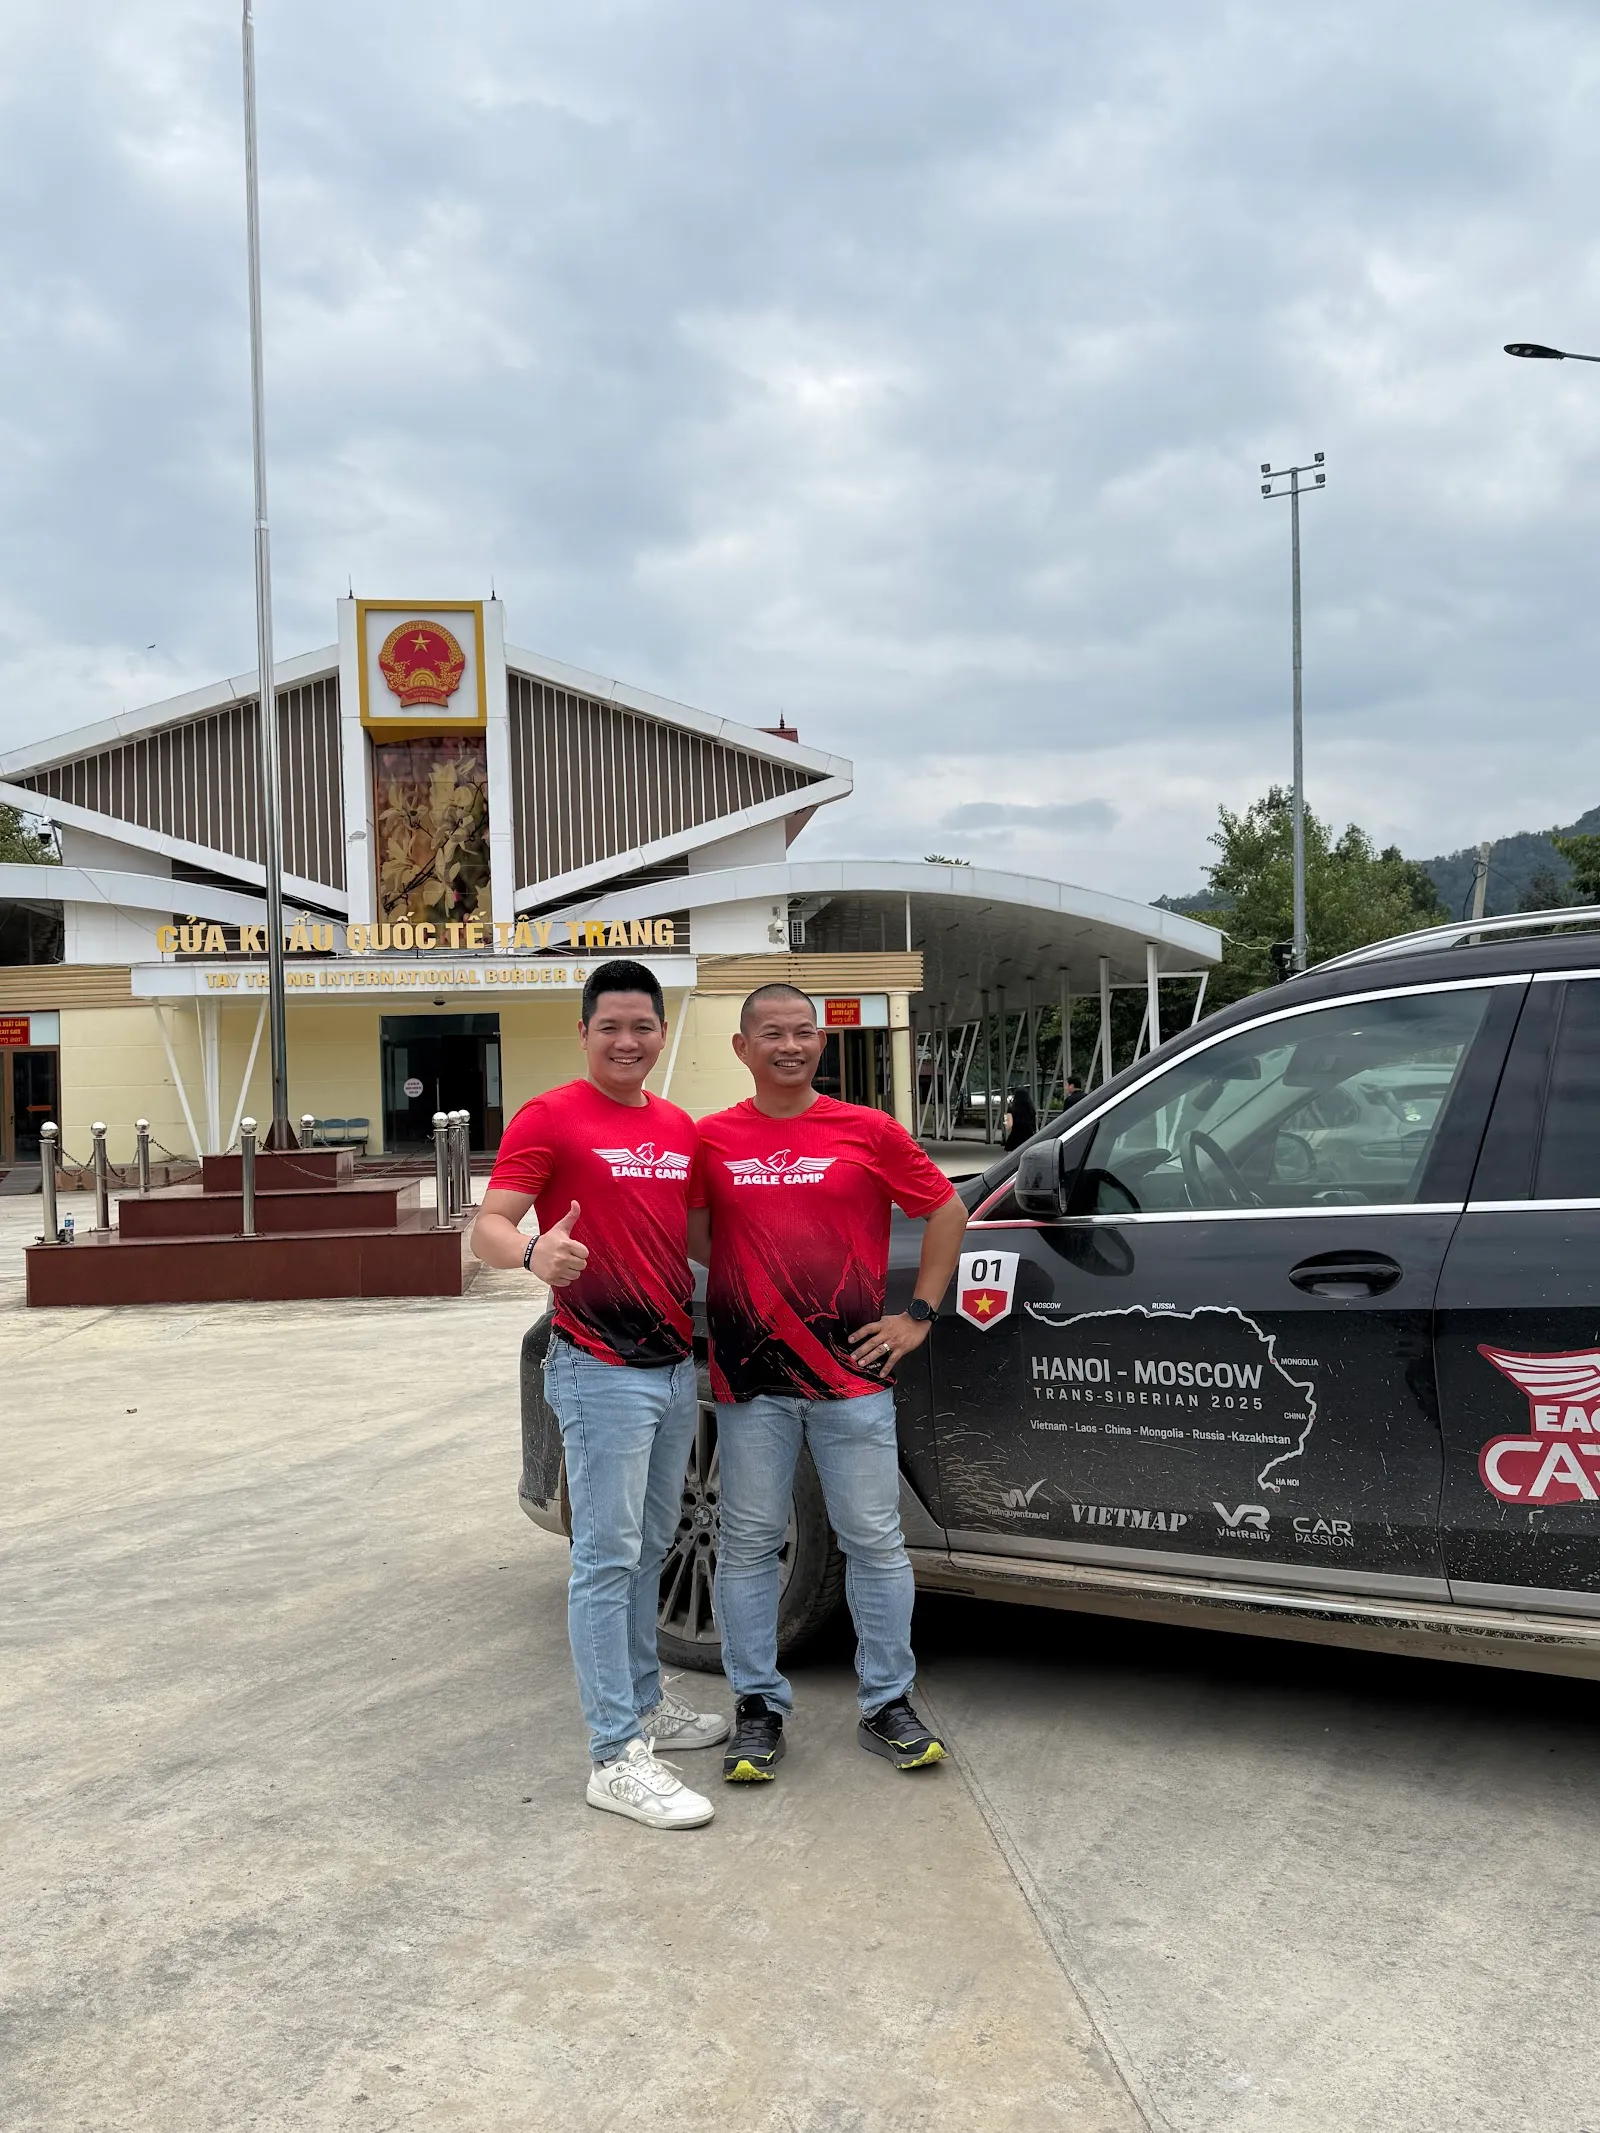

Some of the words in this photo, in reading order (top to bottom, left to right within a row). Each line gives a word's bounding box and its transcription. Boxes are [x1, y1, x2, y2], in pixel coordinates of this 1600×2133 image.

[156, 915, 227, 953] CỬA
[346, 912, 436, 953] QUỐC
[446, 911, 485, 950] TẾ
[495, 914, 552, 949] TÂY
[565, 918, 674, 948] TRANG
[205, 973, 240, 989] TAY
[245, 972, 315, 988] TRNG
[319, 969, 480, 987] INTERNATIONAL
[485, 968, 567, 984] BORDER
[611, 1165, 653, 1179] EAGLE
[655, 1167, 688, 1181] CAMP
[733, 1174, 781, 1186] EAGLE
[783, 1172, 825, 1185] CAMP
[971, 1258, 1002, 1282] 01
[1032, 1302, 1062, 1310] MOSCOW
[1151, 1302, 1176, 1310] RUSSIA
[1280, 1357, 1319, 1368] MONGOLIA
[1031, 1356, 1111, 1383] HANOI
[1134, 1359, 1264, 1389] MOSCOW
[1033, 1386, 1199, 1407] TRANS-SIBERIAN
[1210, 1395, 1264, 1411] 2025
[1283, 1410, 1307, 1421] CHINA
[1029, 1419, 1068, 1432] Vietnam
[1075, 1421, 1097, 1434] Laos
[1104, 1423, 1132, 1436] China
[1139, 1425, 1184, 1441] Mongolia
[1192, 1430, 1226, 1441] Russia
[1275, 1477, 1286, 1486] HA
[1287, 1478, 1300, 1487] NOI
[1212, 1502, 1271, 1531] VR
[1216, 1527, 1271, 1543] VietRally
[1292, 1517, 1353, 1537] CAR
[1294, 1532, 1355, 1548] PASSION
